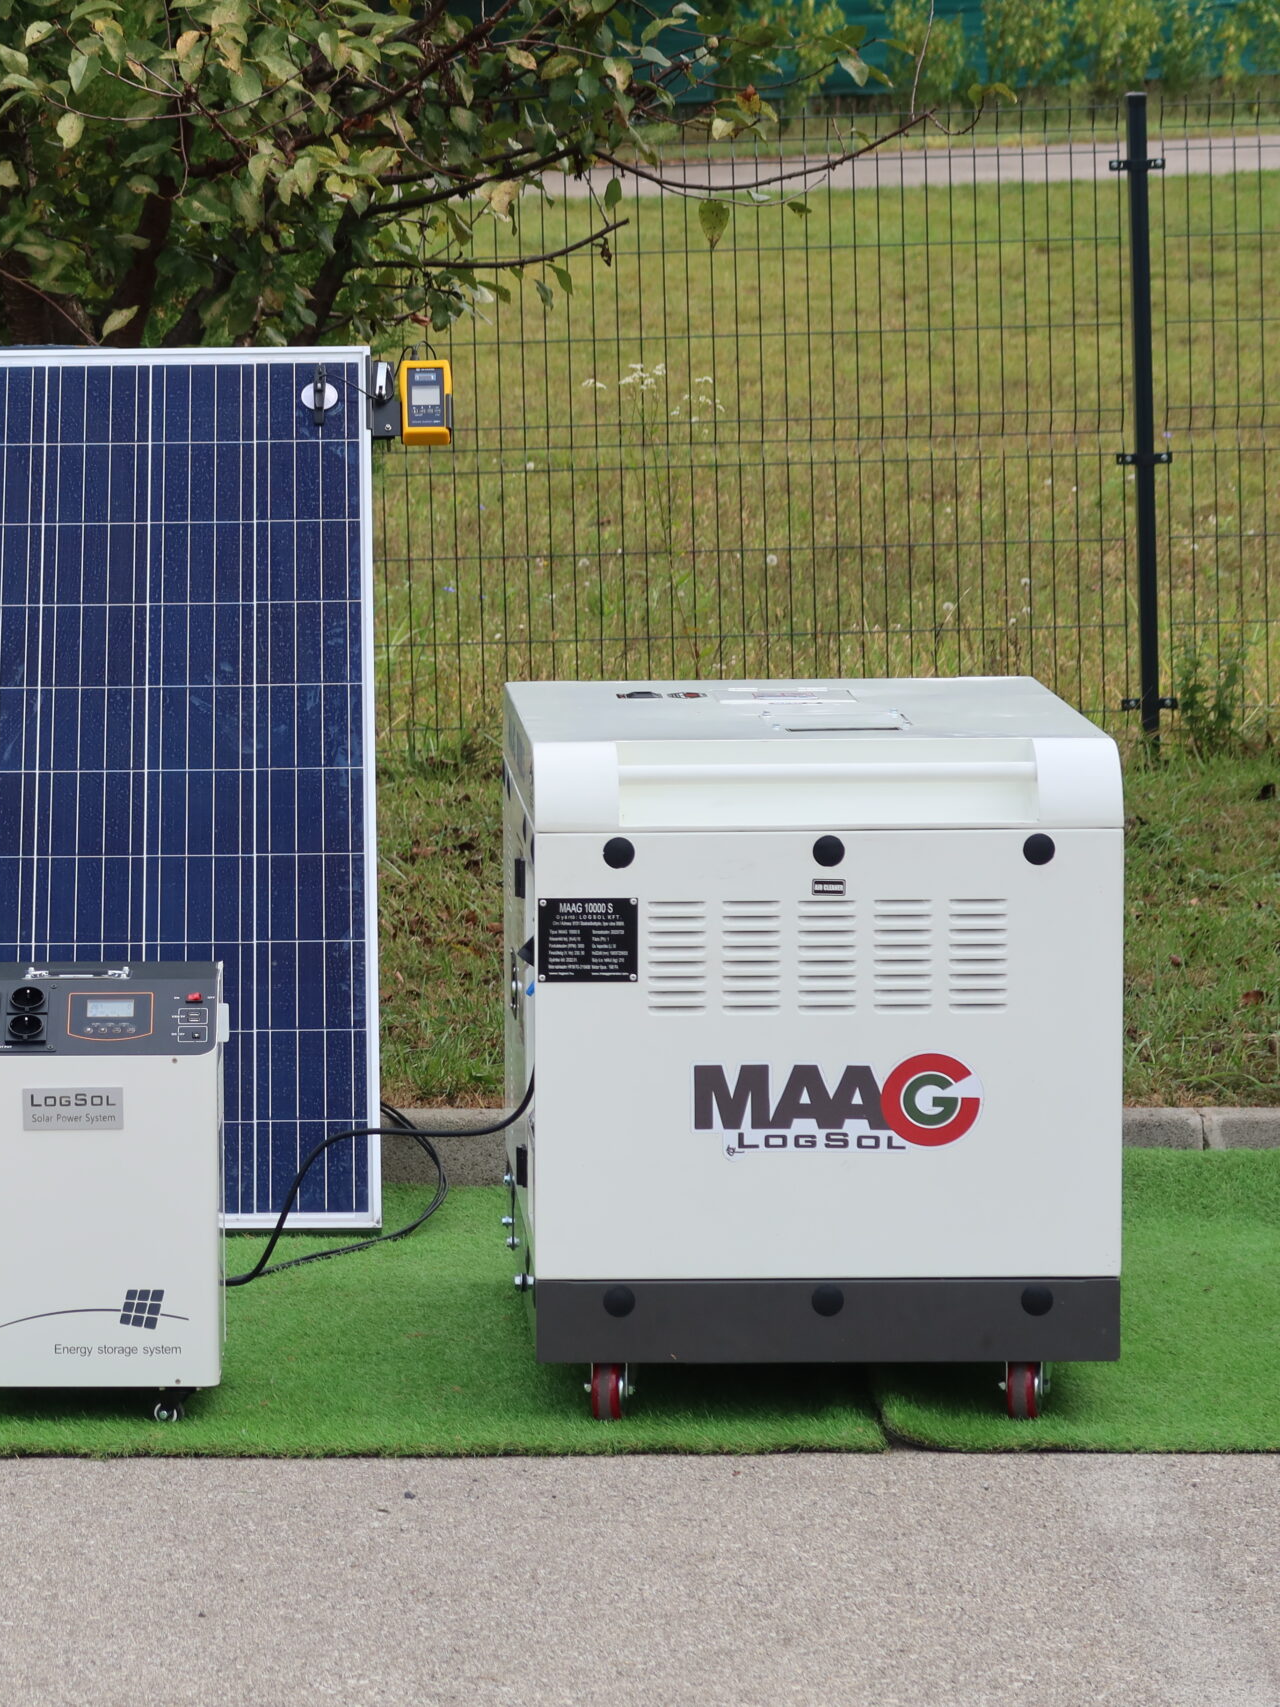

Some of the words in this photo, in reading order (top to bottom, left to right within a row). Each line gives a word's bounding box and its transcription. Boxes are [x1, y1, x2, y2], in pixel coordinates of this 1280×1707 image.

[559, 902, 582, 913] MAAG
[584, 902, 606, 913] 10000
[607, 902, 613, 913] S
[694, 1053, 980, 1147] MAAG
[32, 1114, 53, 1123] Solar
[56, 1113, 82, 1123] Power
[85, 1113, 116, 1125] System
[54, 1344, 93, 1357] Energy
[97, 1344, 138, 1357] storage
[142, 1345, 182, 1357] system
